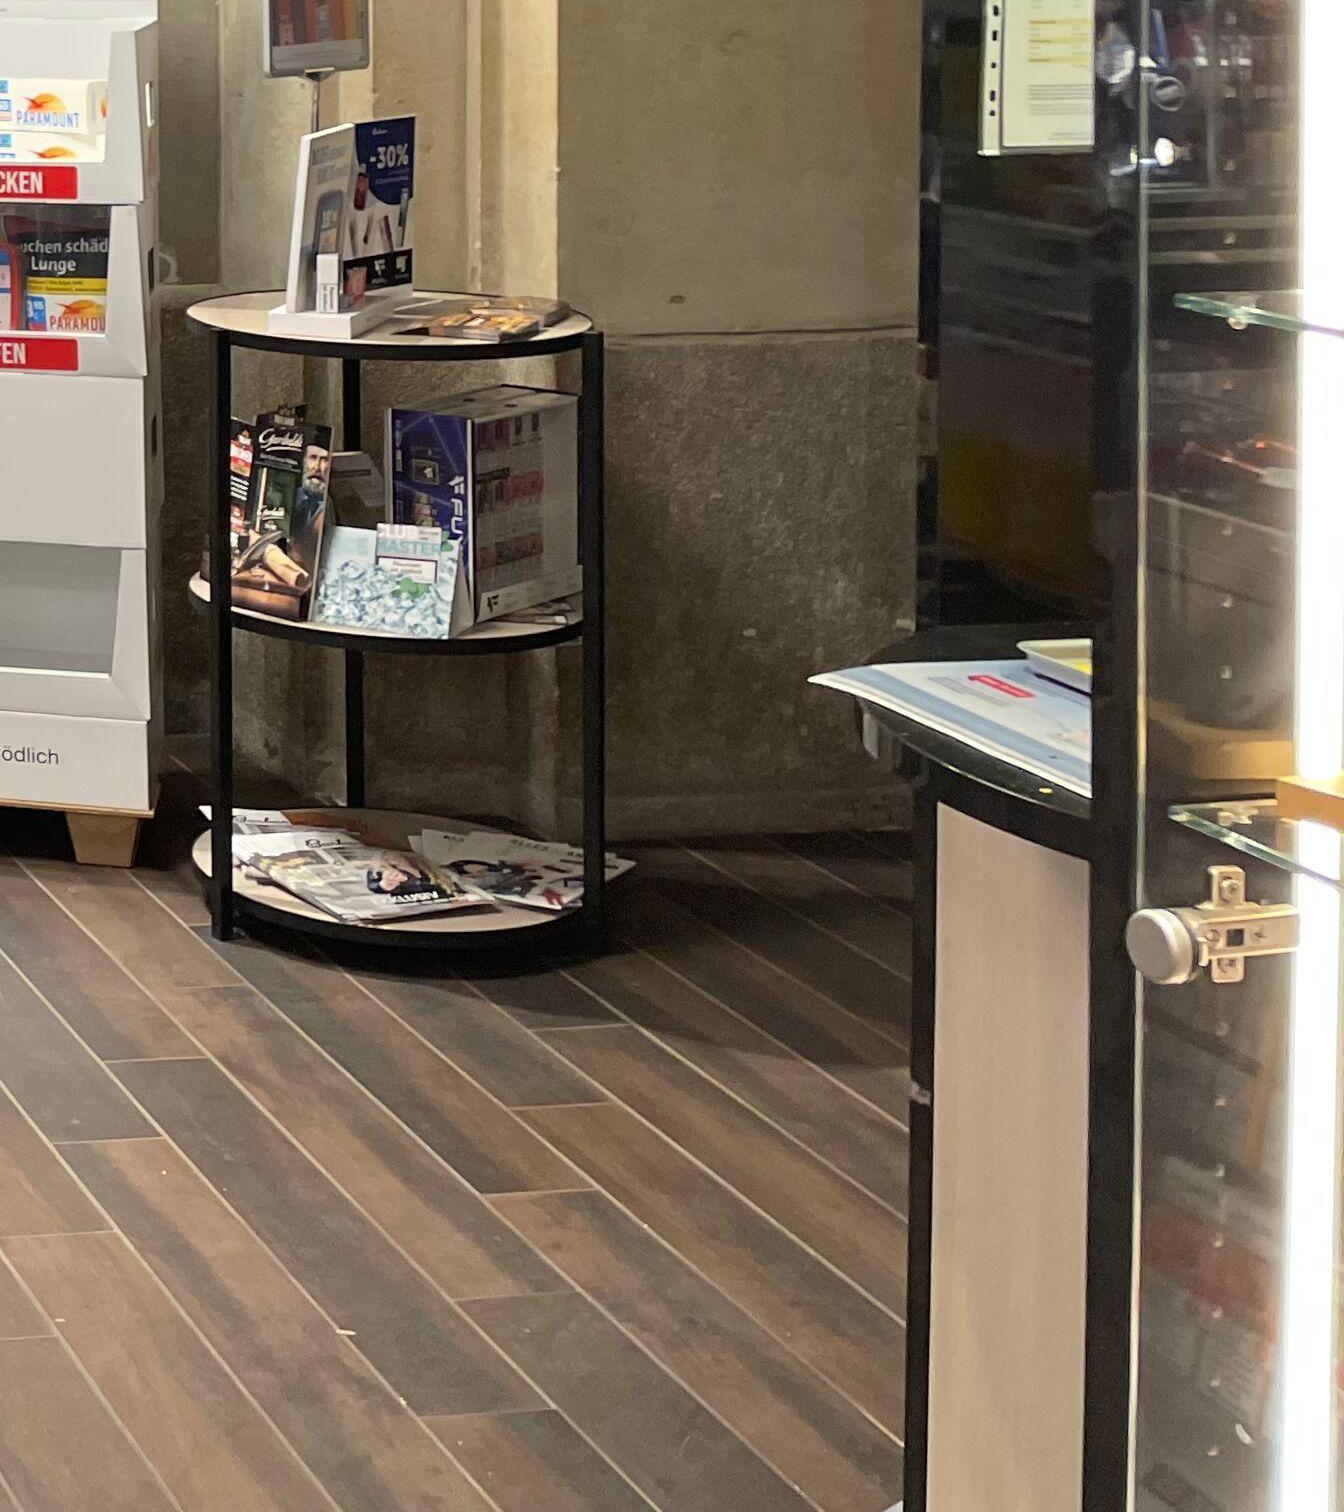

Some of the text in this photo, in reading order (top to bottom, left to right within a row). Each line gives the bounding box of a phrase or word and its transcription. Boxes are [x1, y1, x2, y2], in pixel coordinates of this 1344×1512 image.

[15, 109, 81, 129] PARAMOUNT
[369, 143, 410, 170] -30%
[30, 256, 78, 276] Lunge
